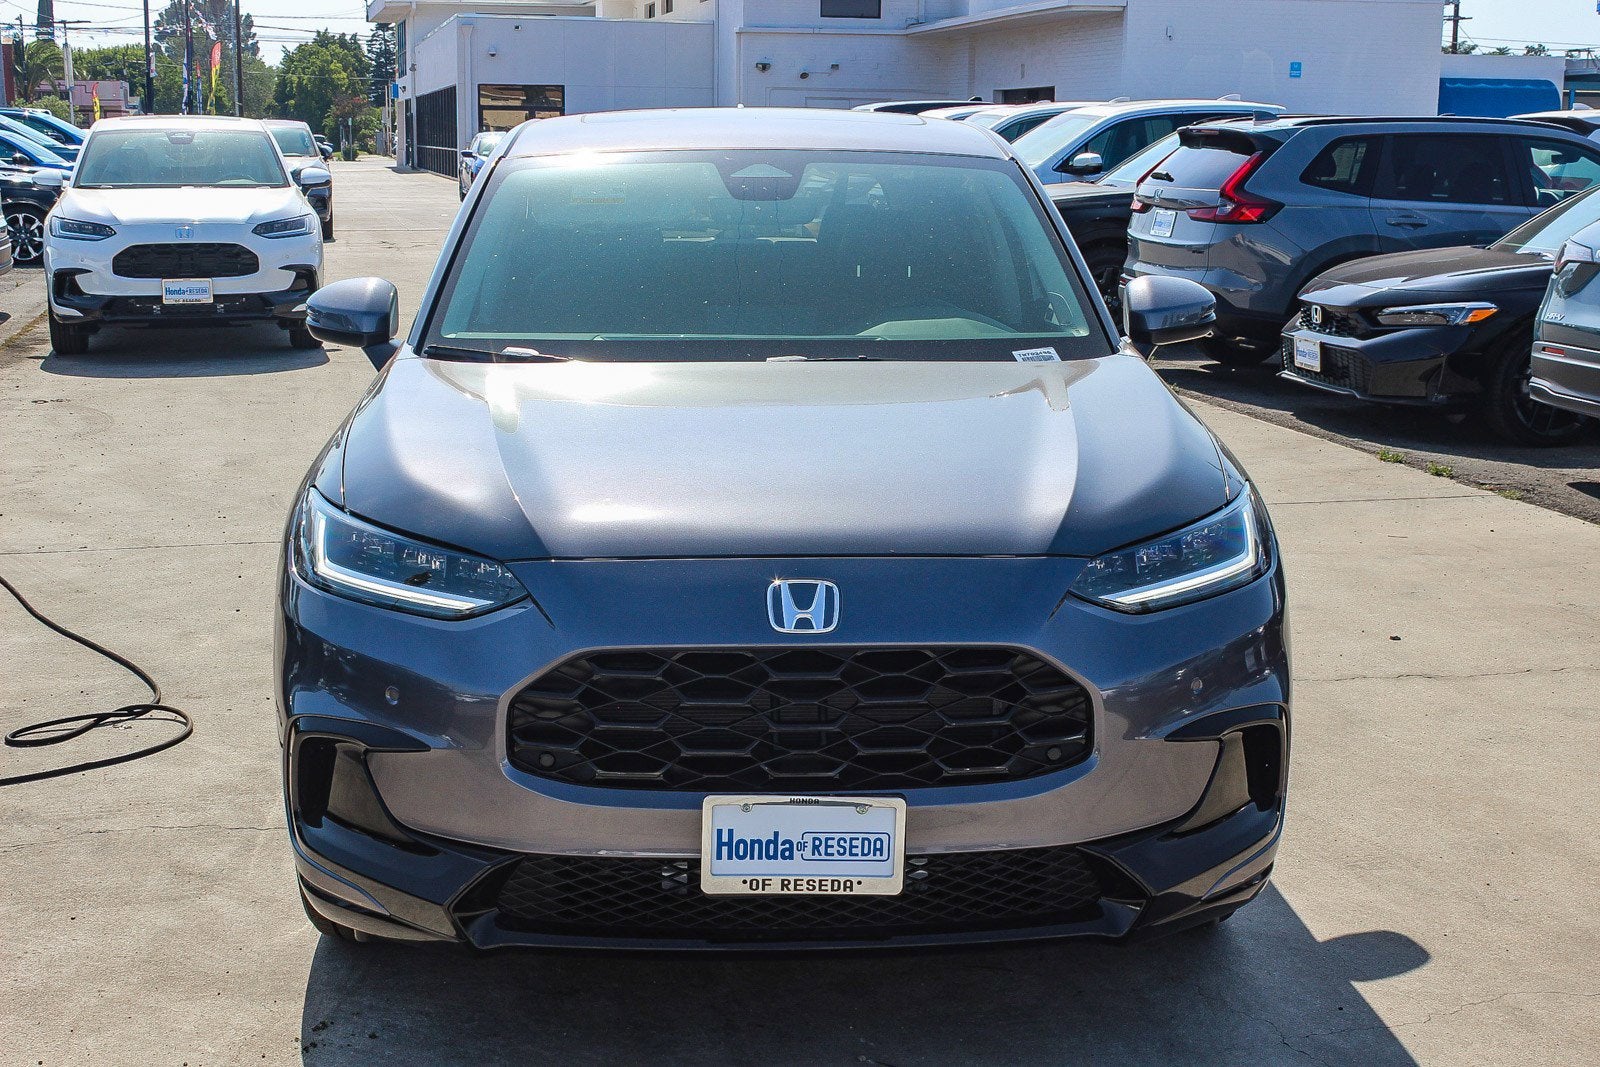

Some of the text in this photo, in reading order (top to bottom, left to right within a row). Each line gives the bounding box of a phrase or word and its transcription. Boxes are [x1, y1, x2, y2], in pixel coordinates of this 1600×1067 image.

[165, 286, 185, 296] Honda
[716, 828, 884, 861] Honda OF RESEDA
[749, 878, 854, 892] OF RESEDA
